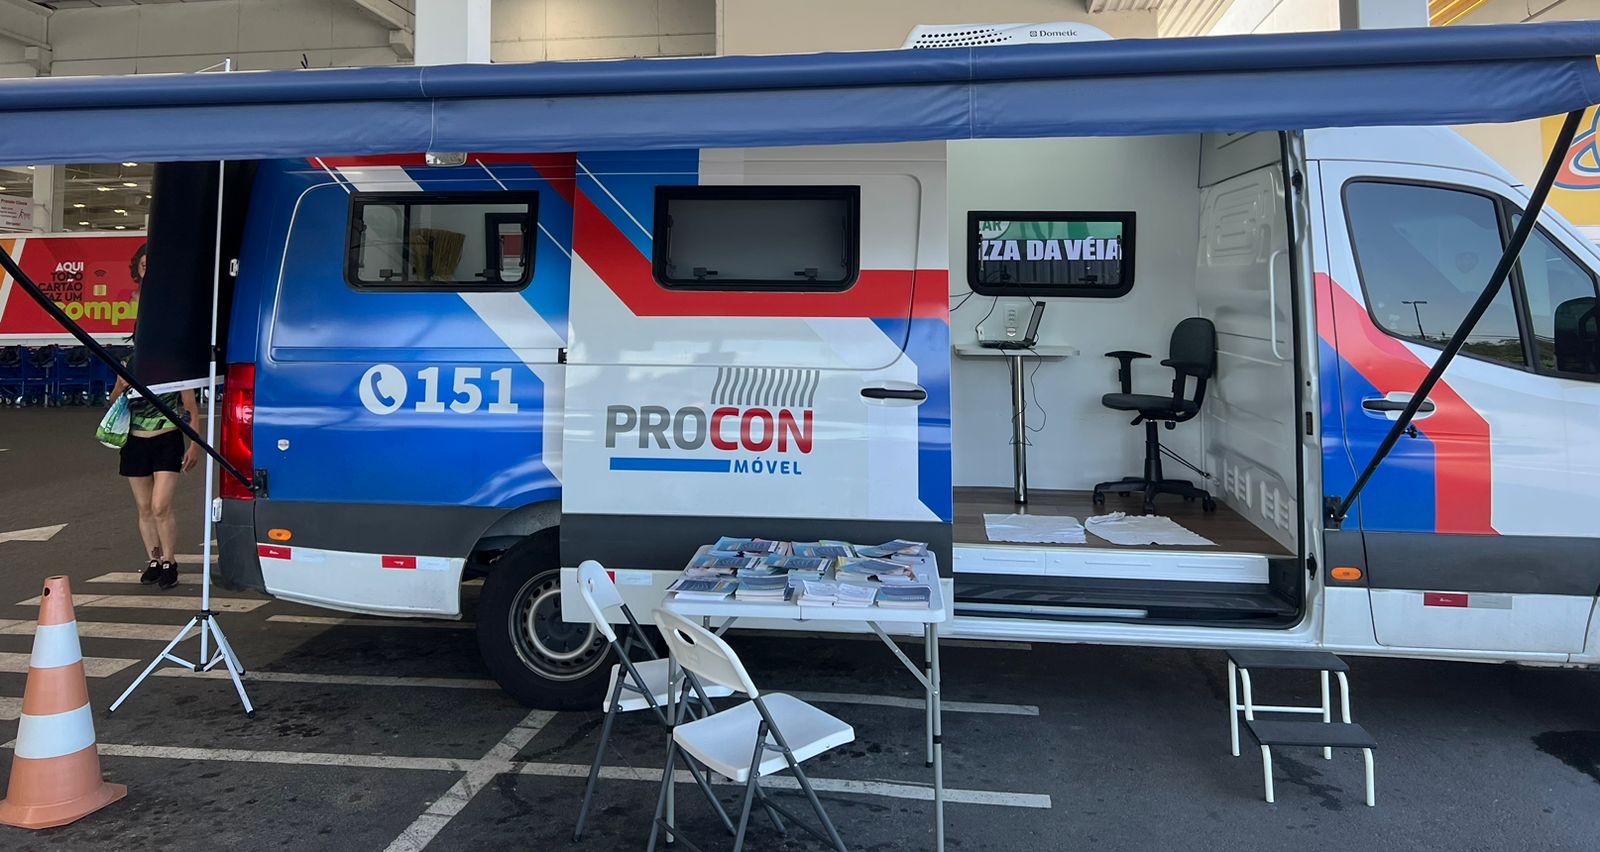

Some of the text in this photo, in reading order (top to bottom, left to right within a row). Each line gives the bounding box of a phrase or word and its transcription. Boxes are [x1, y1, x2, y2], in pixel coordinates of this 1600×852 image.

[1039, 29, 1078, 37] Dometic
[978, 221, 1002, 231] AR
[1026, 239, 1062, 261] DA
[1063, 236, 1122, 261] VÉIA
[55, 261, 84, 274] AQUI
[65, 292, 83, 301] UM
[415, 366, 519, 414] 151
[605, 404, 813, 454] PROCON
[733, 456, 802, 475] MÓVEL
